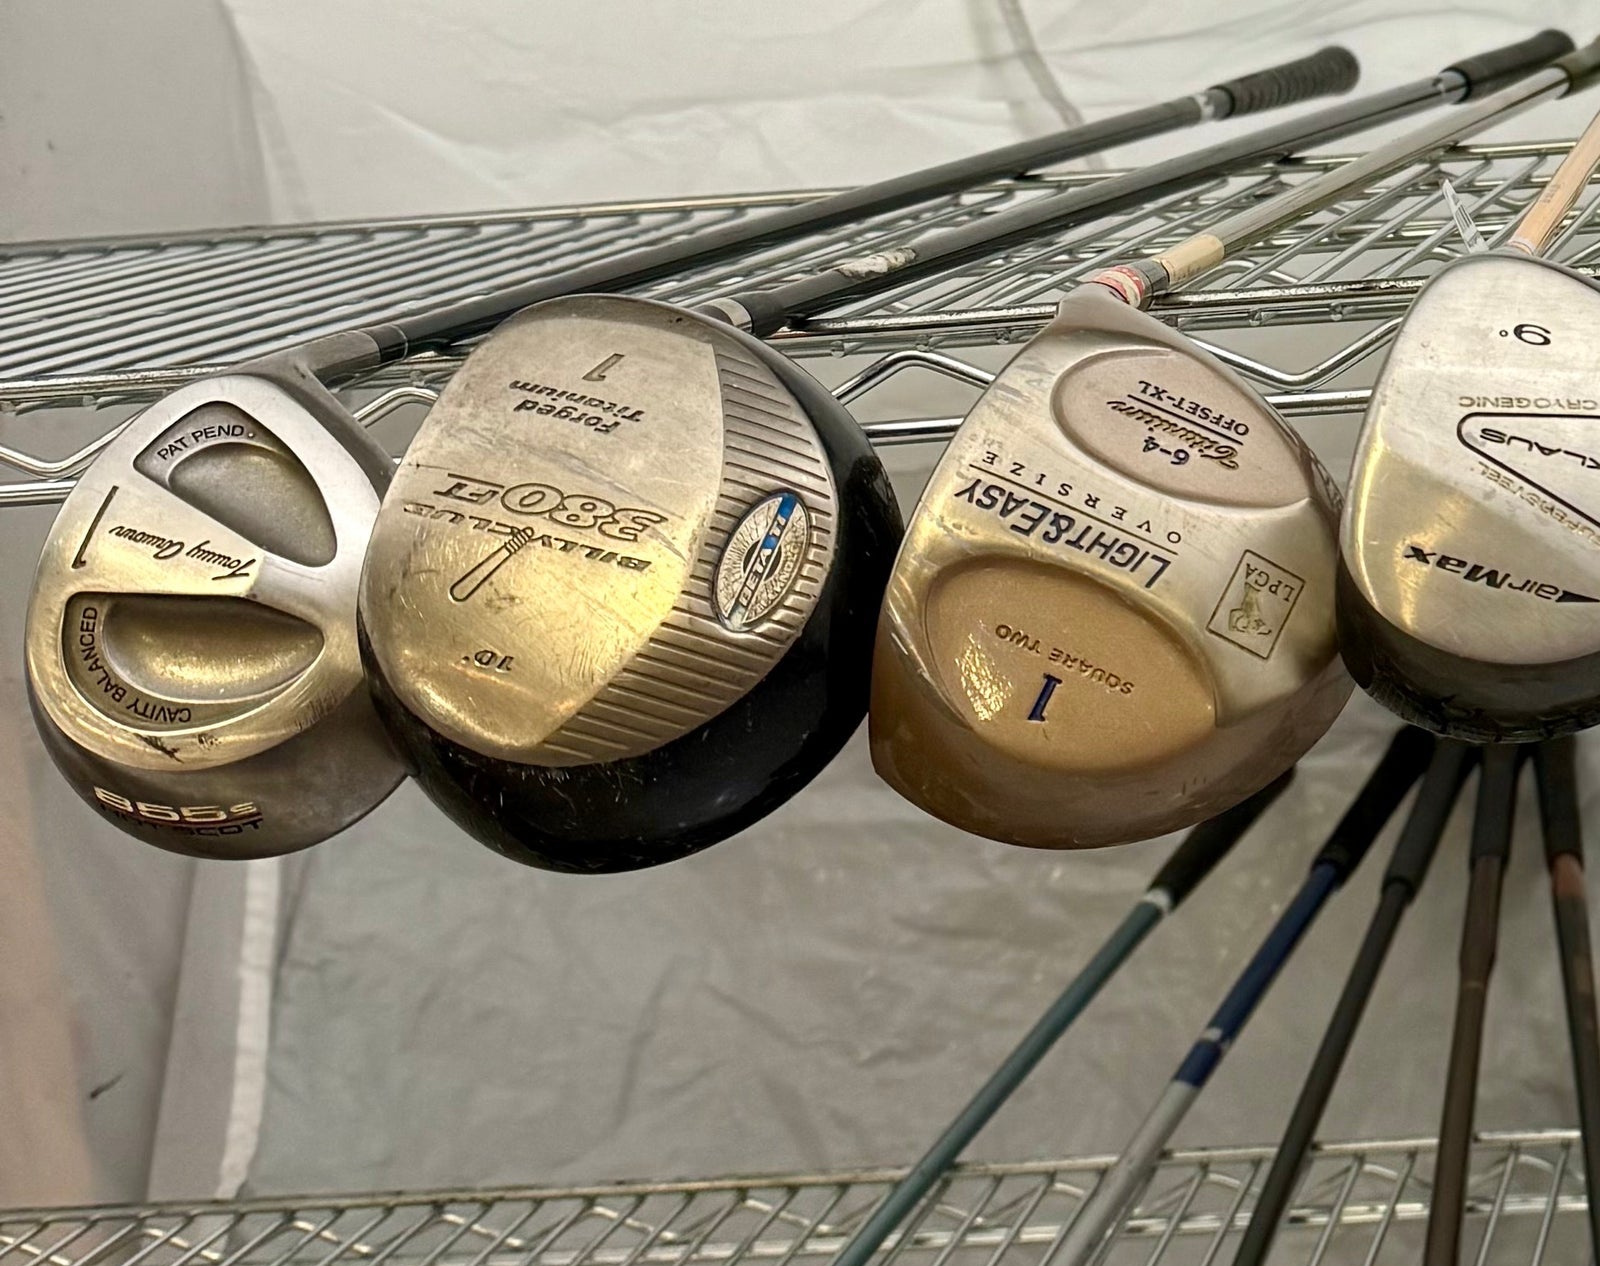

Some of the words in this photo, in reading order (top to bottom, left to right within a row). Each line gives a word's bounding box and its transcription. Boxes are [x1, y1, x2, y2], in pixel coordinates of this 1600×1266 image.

[582, 353, 626, 382] 1
[509, 379, 648, 424] Titanium
[513, 398, 624, 436] Forged
[1138, 379, 1250, 437] OFFSET-XL
[1458, 395, 1599, 411] CRYOGENIC
[156, 437, 189, 462] PAT
[1106, 398, 1240, 472] Titanium
[1141, 434, 1191, 467] 6-4
[981, 448, 1181, 546] OVERSIZE
[71, 486, 120, 569] 1
[108, 524, 185, 559] Armour
[954, 478, 1172, 591] LIGHT&EASY
[184, 539, 257, 582] Tommy
[1242, 561, 1296, 604] LPGA
[1403, 545, 1562, 601] airMax
[79, 606, 128, 703] BALANCED
[995, 623, 1041, 654] TWO
[1048, 646, 1135, 696] SQUARE
[127, 699, 193, 724] CAVITY
[1026, 673, 1064, 723] 1
